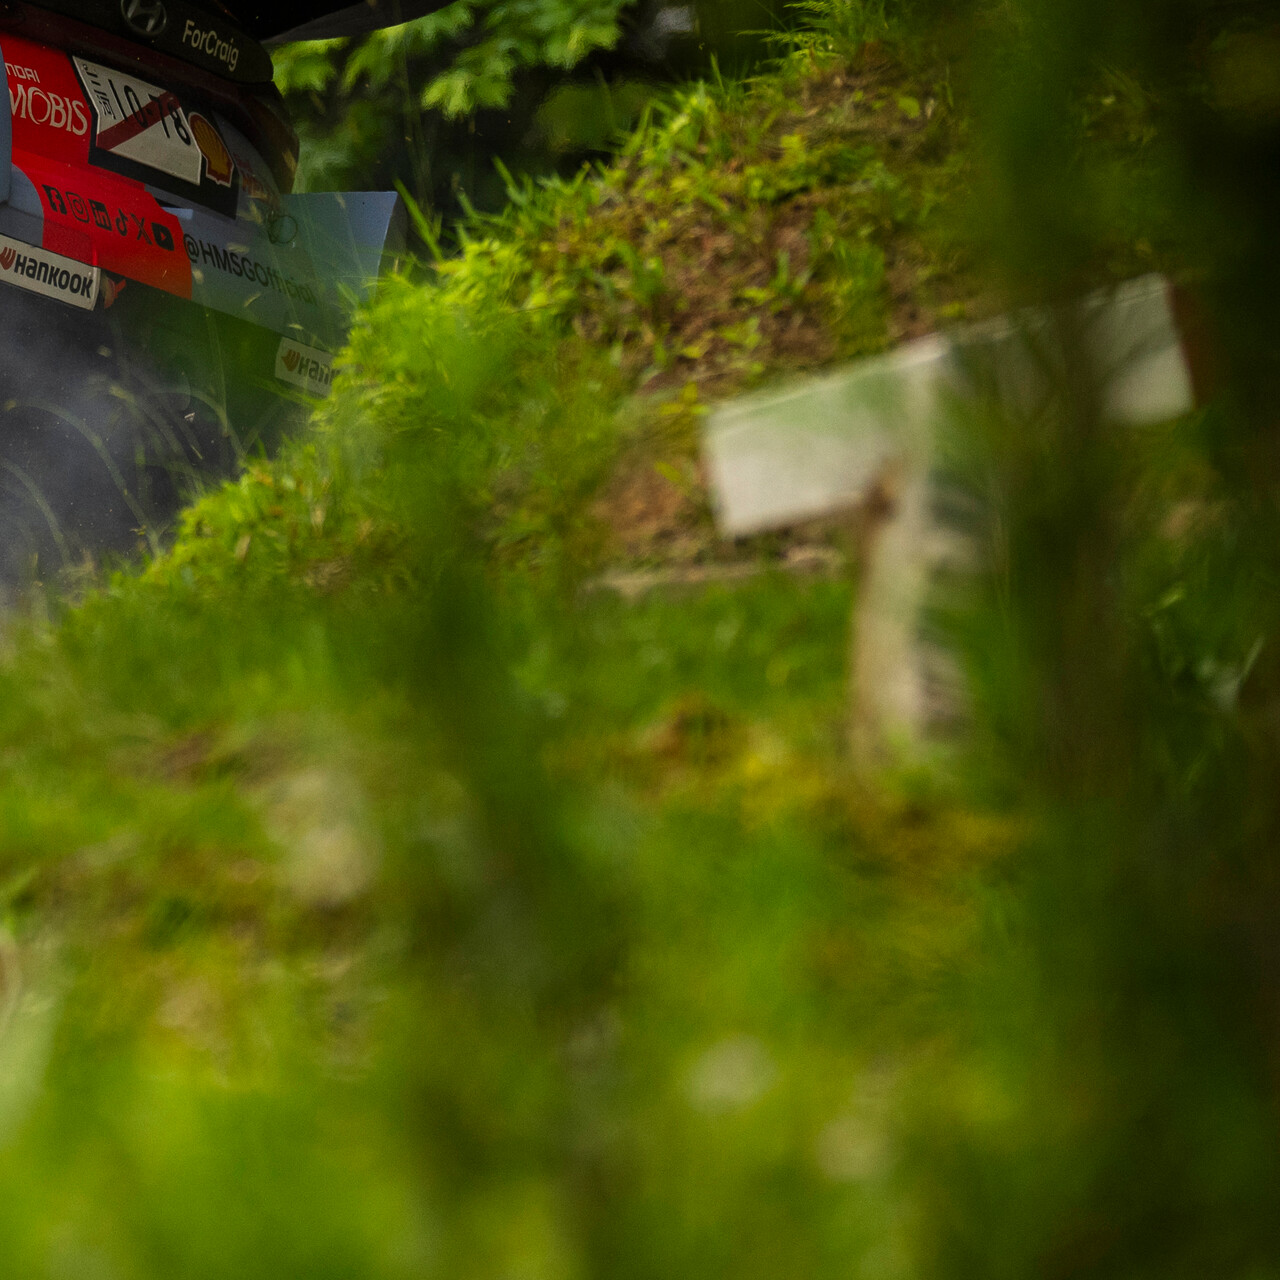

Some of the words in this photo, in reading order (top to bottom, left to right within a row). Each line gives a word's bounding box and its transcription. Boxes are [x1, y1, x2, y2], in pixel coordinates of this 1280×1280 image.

[182, 19, 240, 72] ForCraig
[5, 62, 40, 83] NDAI
[8, 84, 88, 135] MOBIS
